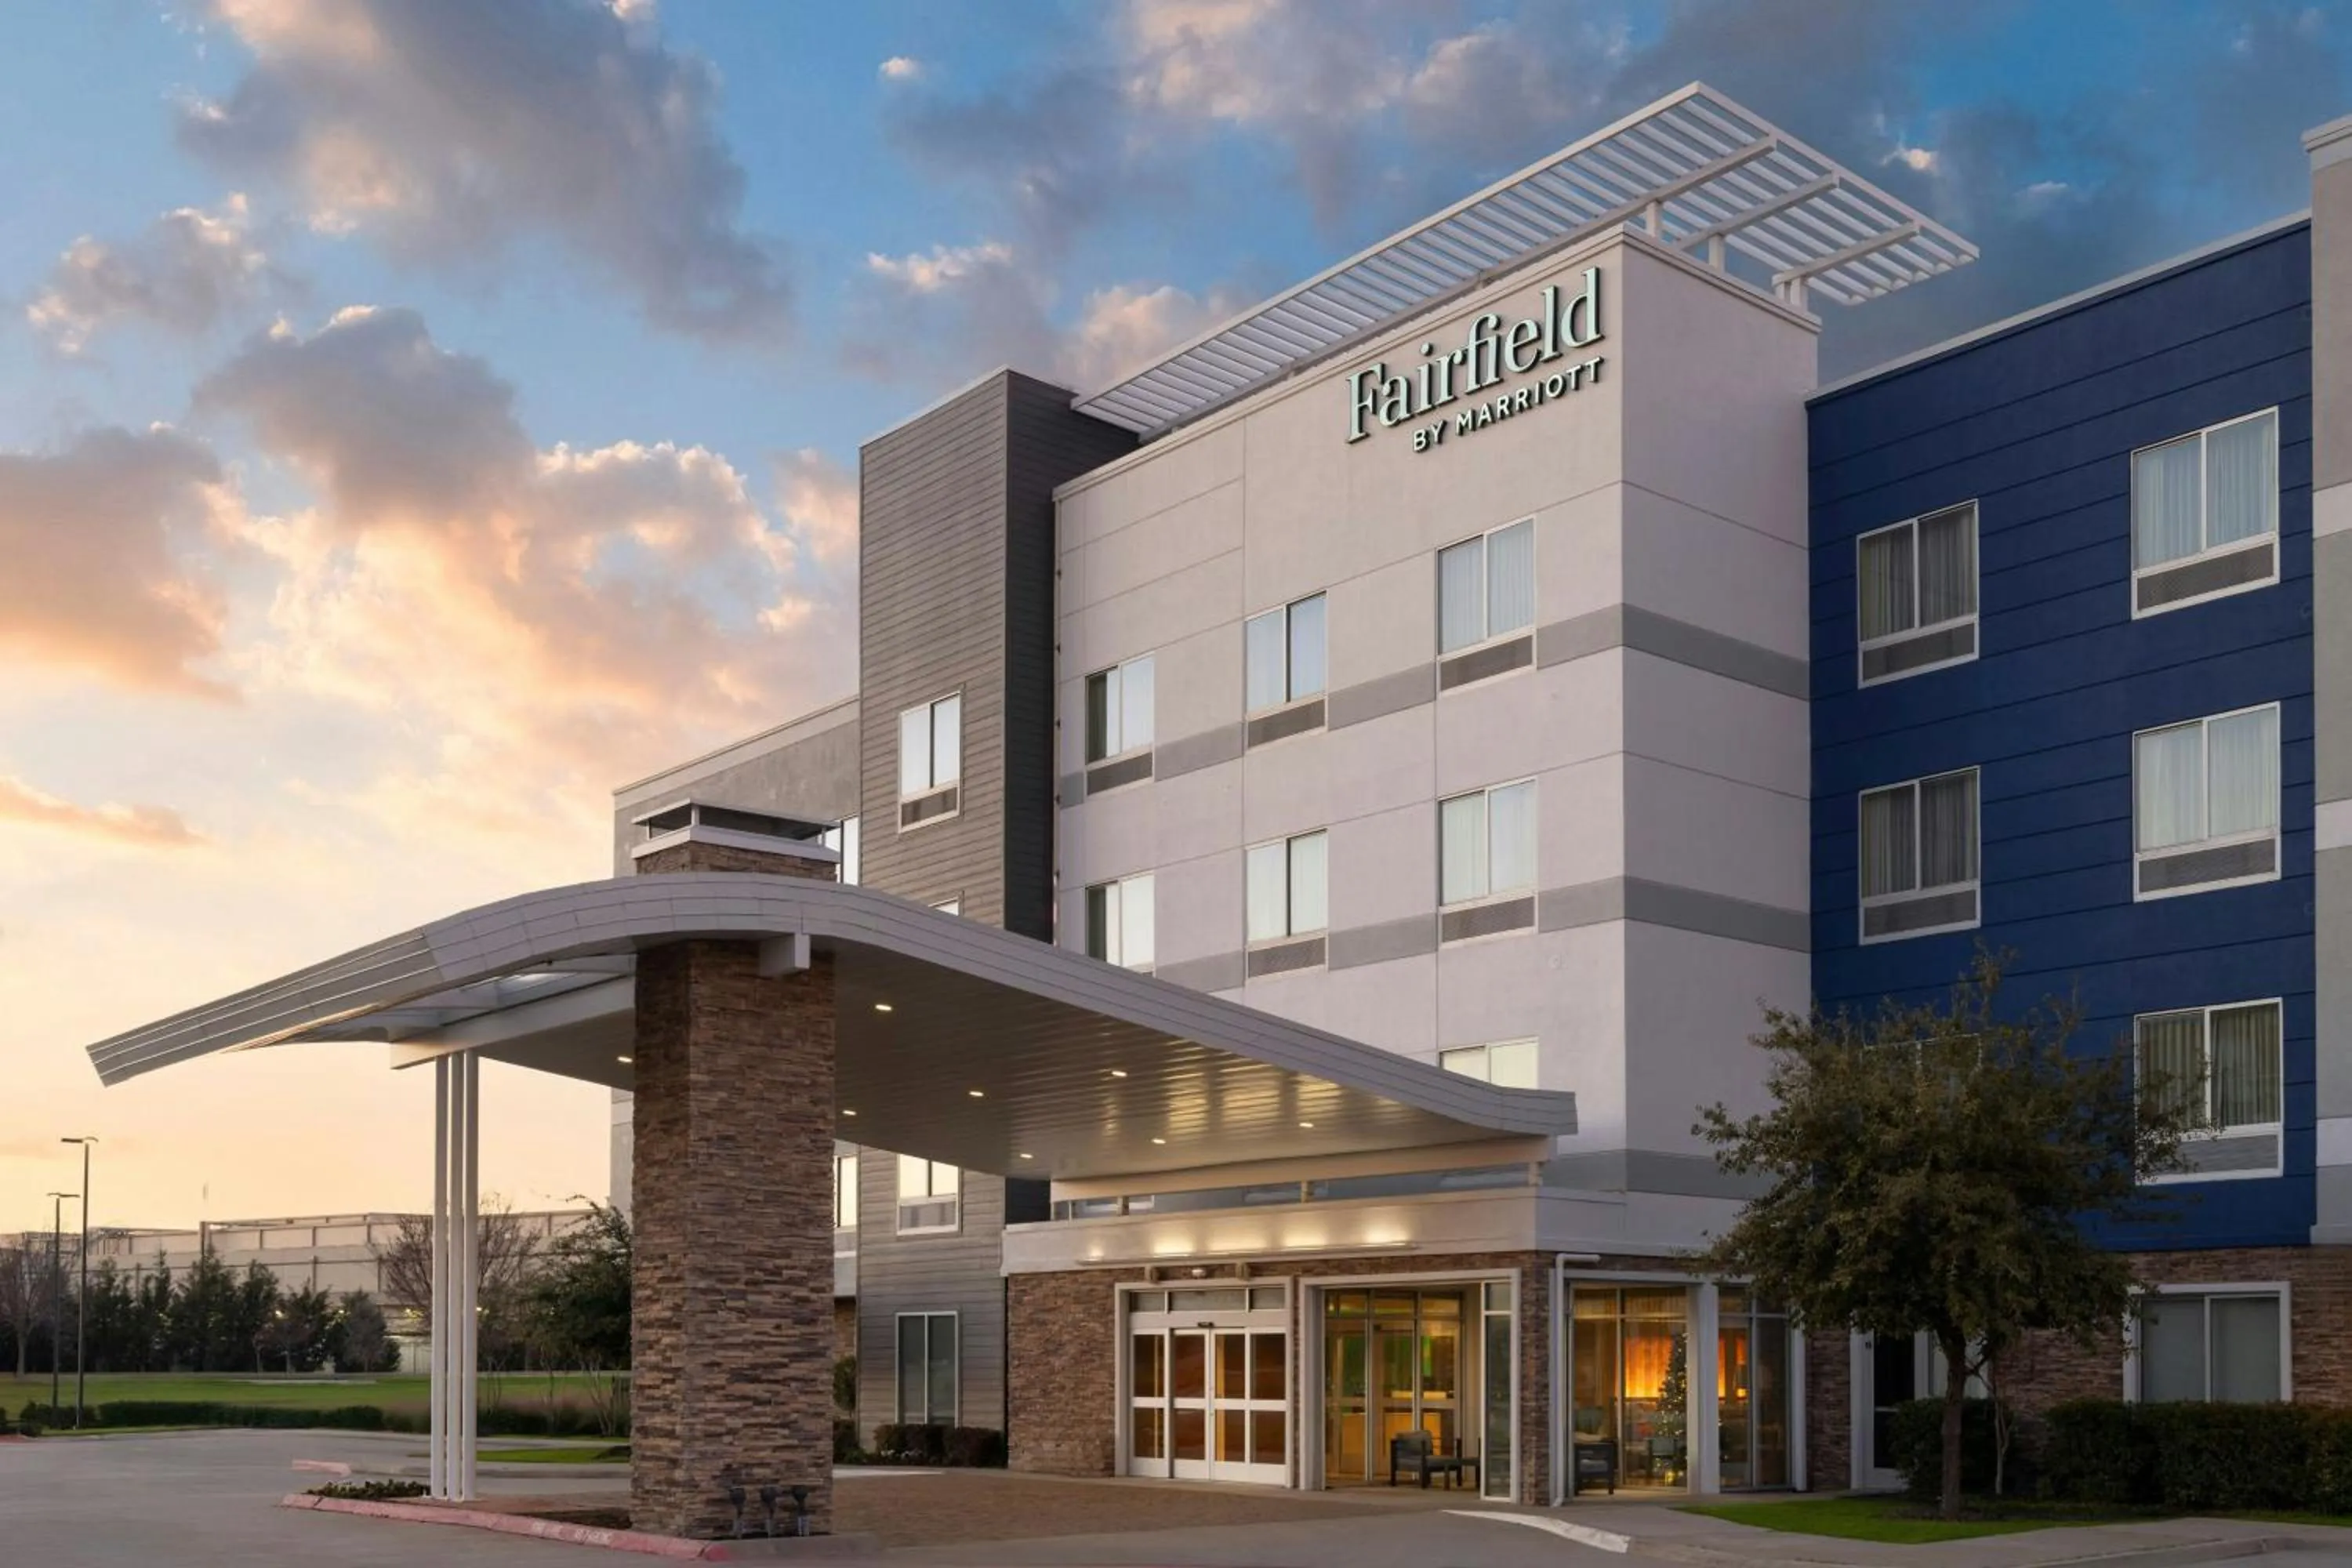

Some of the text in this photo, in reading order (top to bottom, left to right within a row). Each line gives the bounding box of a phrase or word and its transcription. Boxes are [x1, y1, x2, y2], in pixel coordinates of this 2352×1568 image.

[1346, 267, 1605, 444] Fairfield
[1413, 357, 1604, 453] BY MARRIOTT
